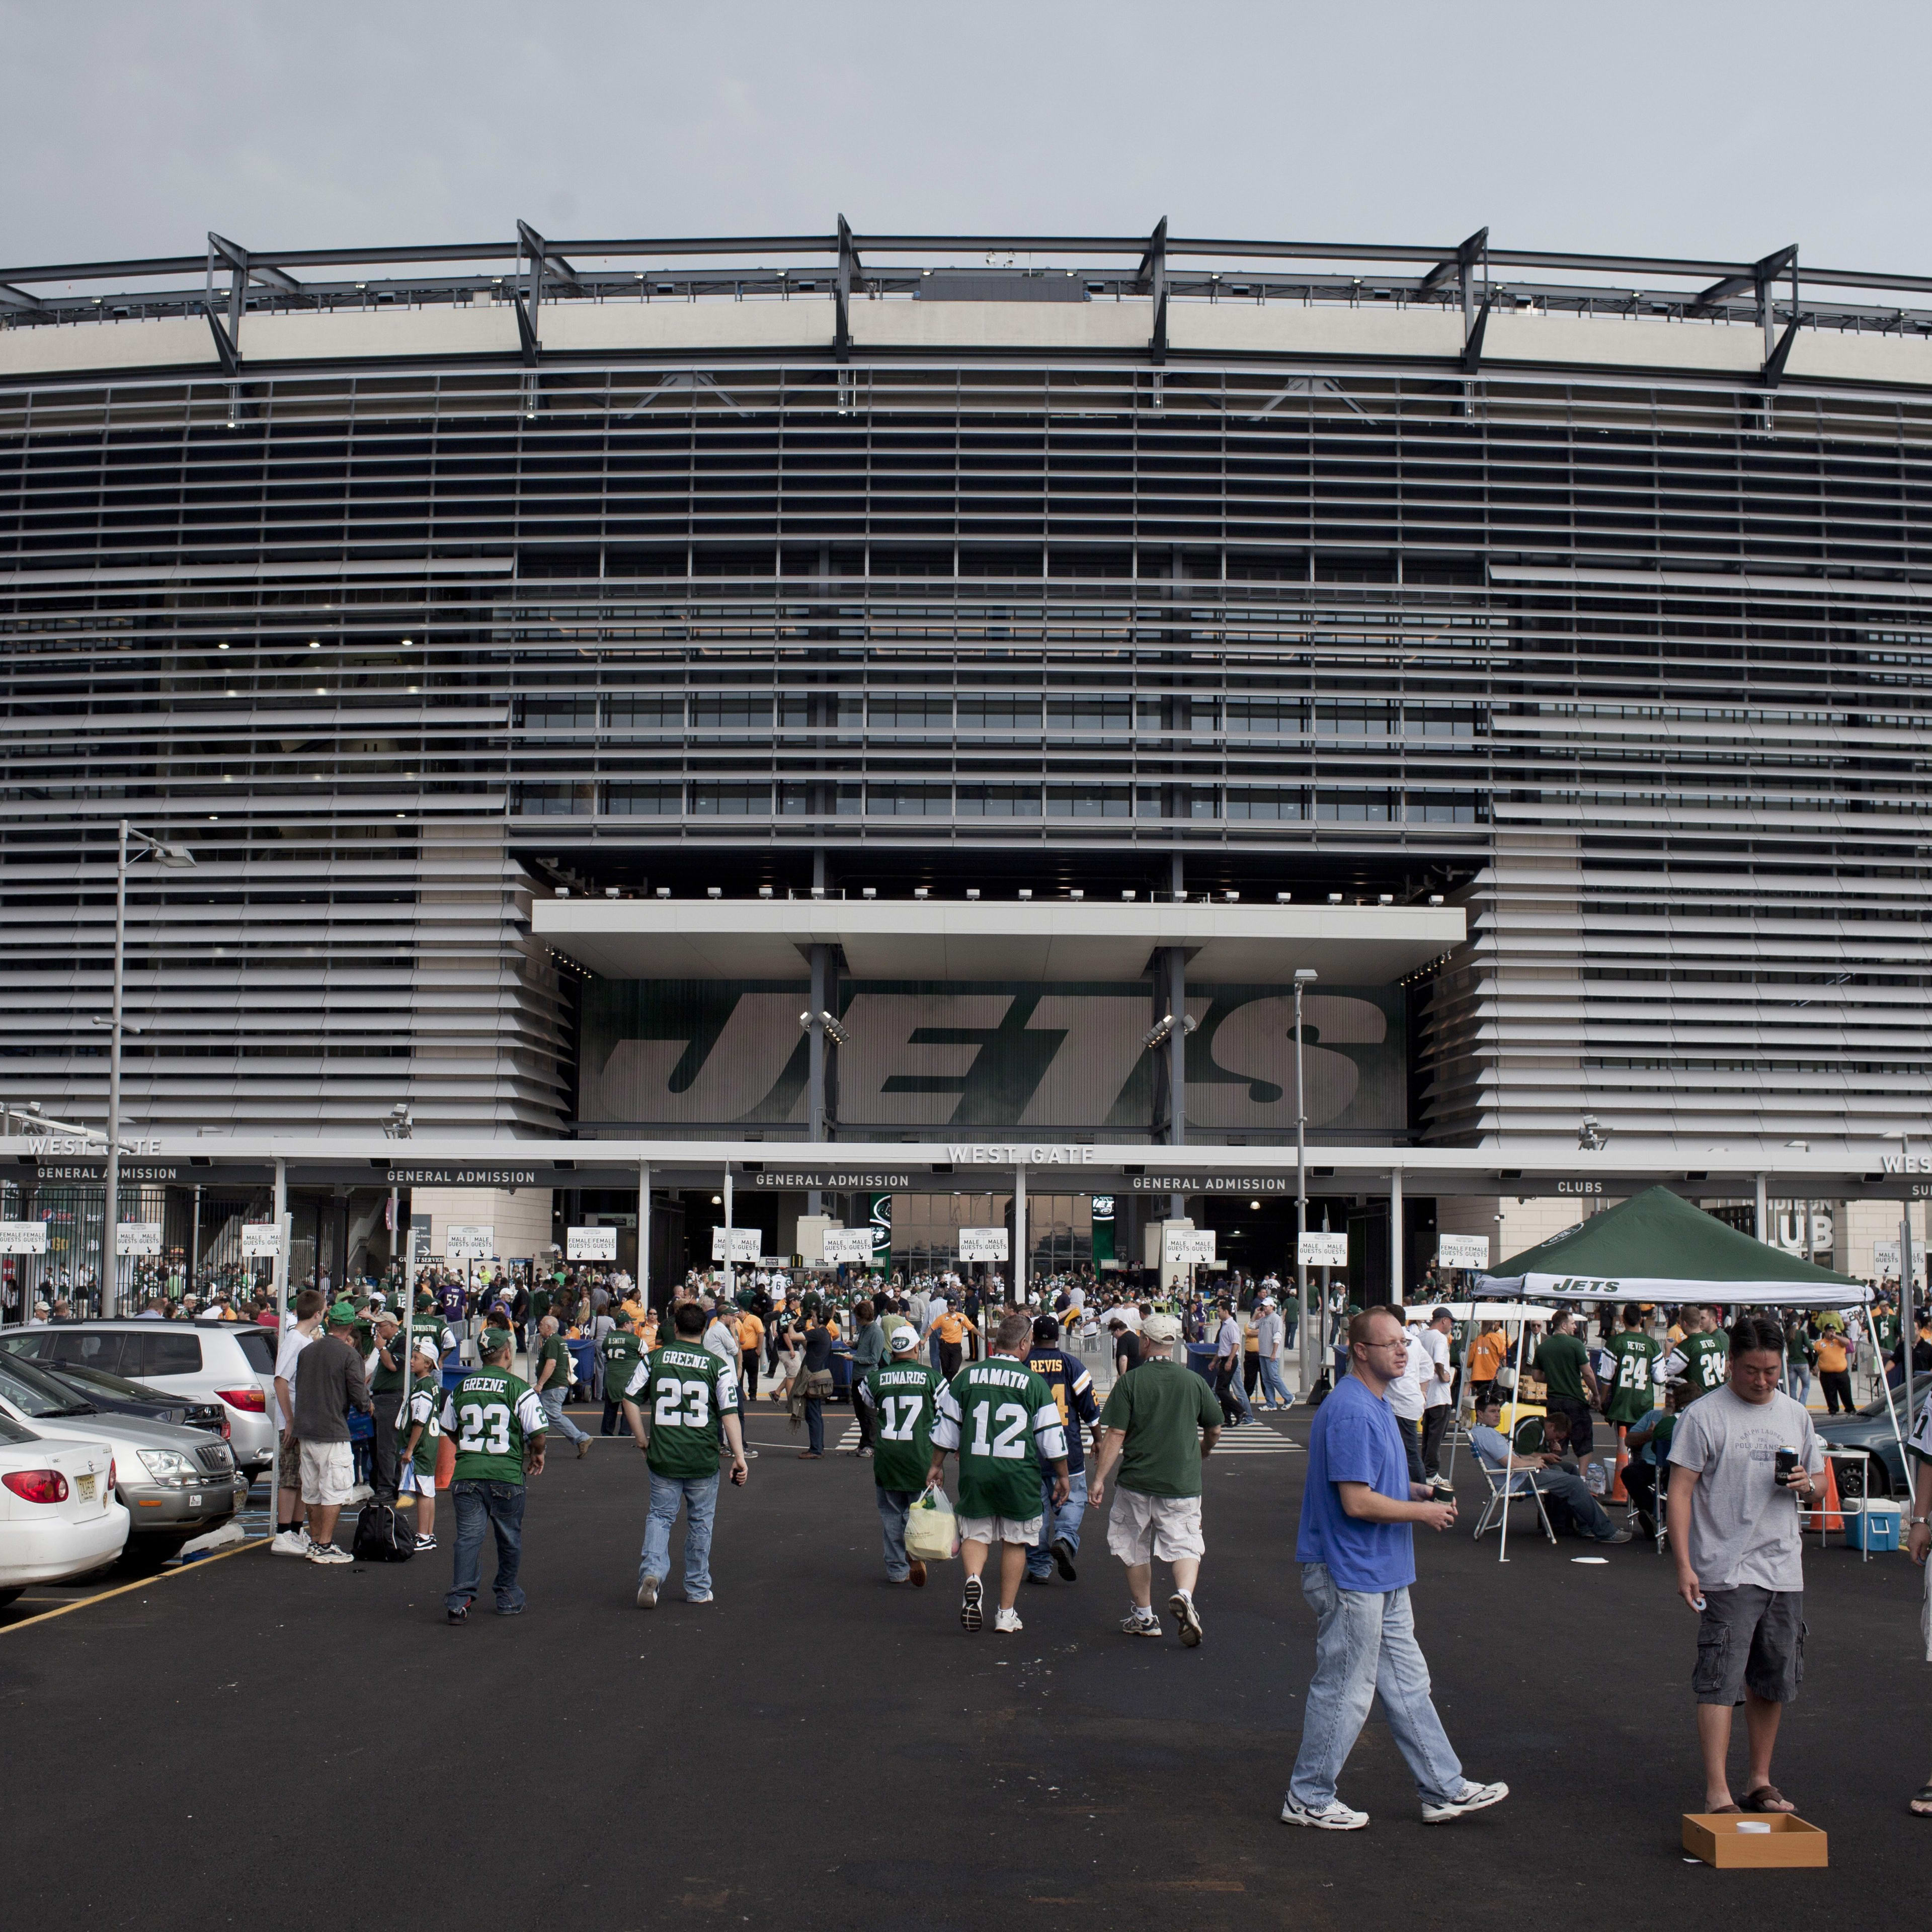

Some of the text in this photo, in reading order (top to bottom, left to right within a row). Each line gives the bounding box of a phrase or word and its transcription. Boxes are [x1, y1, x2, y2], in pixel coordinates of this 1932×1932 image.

[601, 992, 1388, 1128] JETS
[28, 1138, 91, 1155] WEST
[947, 1146, 1094, 1164] WEST GATE
[38, 1168, 97, 1178] GENERAL
[387, 1171, 535, 1182] GENERAL ADMISSION
[756, 1174, 909, 1186] GENERAL ADMISSION
[1133, 1177, 1285, 1190] GENERAL ADMISSION
[1558, 1181, 1602, 1193] CLUBS
[1553, 1278, 1620, 1293] JETS
[446, 1294, 459, 1307] 57
[579, 1324, 591, 1335] 86
[1627, 1341, 1646, 1351] REVIS
[662, 1351, 710, 1370] GREENE
[1030, 1359, 1063, 1373] REVIS
[879, 1371, 927, 1386] EDWARDS
[969, 1368, 1029, 1390] NAMATH
[1620, 1355, 1648, 1391] 24
[463, 1377, 507, 1393] GREENE
[655, 1378, 709, 1427] 23
[881, 1396, 923, 1440] 17
[459, 1403, 511, 1454] 23
[971, 1400, 1028, 1459] 12
[1740, 1428, 1785, 1443] RALPH LAUREN
